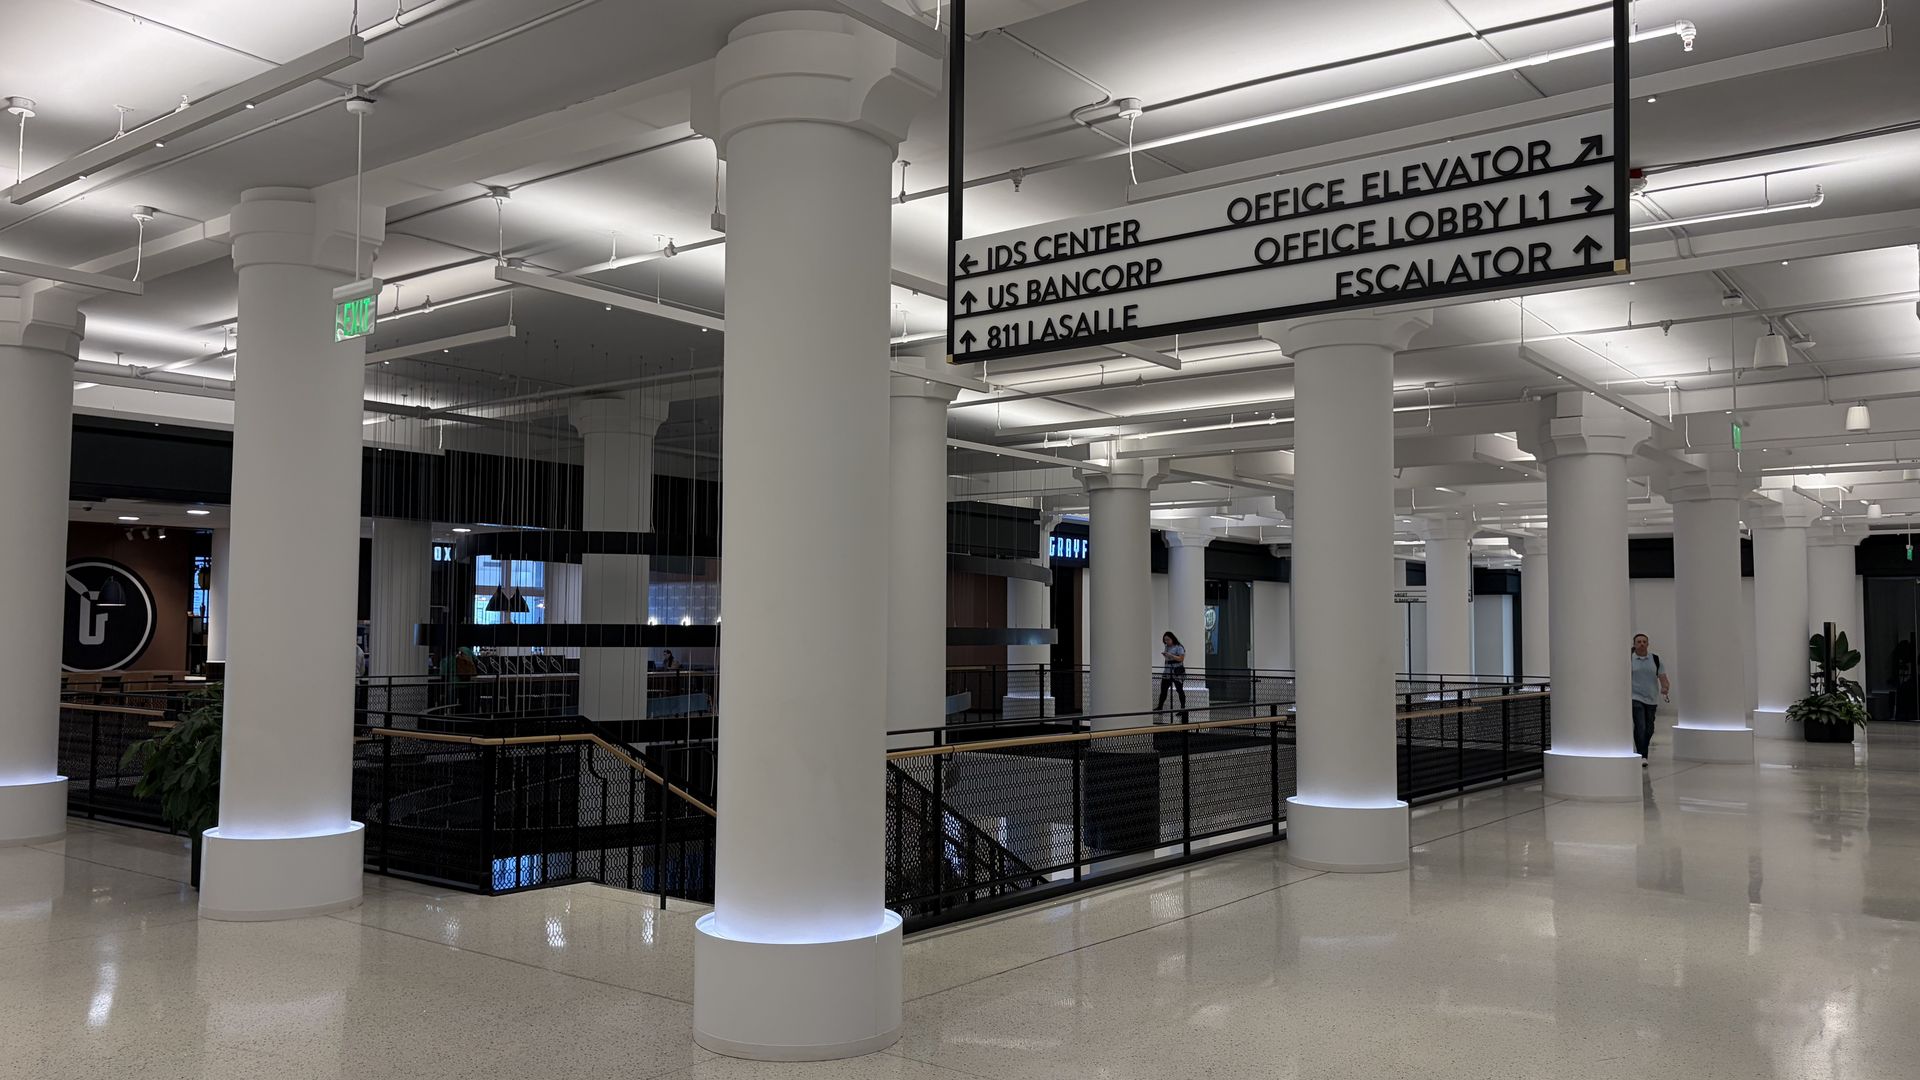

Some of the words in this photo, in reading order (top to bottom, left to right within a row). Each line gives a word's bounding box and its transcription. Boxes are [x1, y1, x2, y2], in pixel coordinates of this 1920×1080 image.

[1227, 178, 1345, 225] OFFICE
[1362, 140, 1551, 201] ELEVATOR
[987, 240, 1027, 272] IDS
[1034, 219, 1141, 261] CENTER
[1254, 220, 1376, 265] OFFICE
[1388, 197, 1508, 244] LOBBY
[1520, 190, 1550, 224] L1
[988, 282, 1019, 309] US
[1027, 258, 1163, 304] BANCORP
[1336, 242, 1552, 300] ESCALATOR
[343, 297, 371, 336] EXIT
[987, 323, 1019, 349] 811
[1028, 304, 1138, 344] LASALLE
